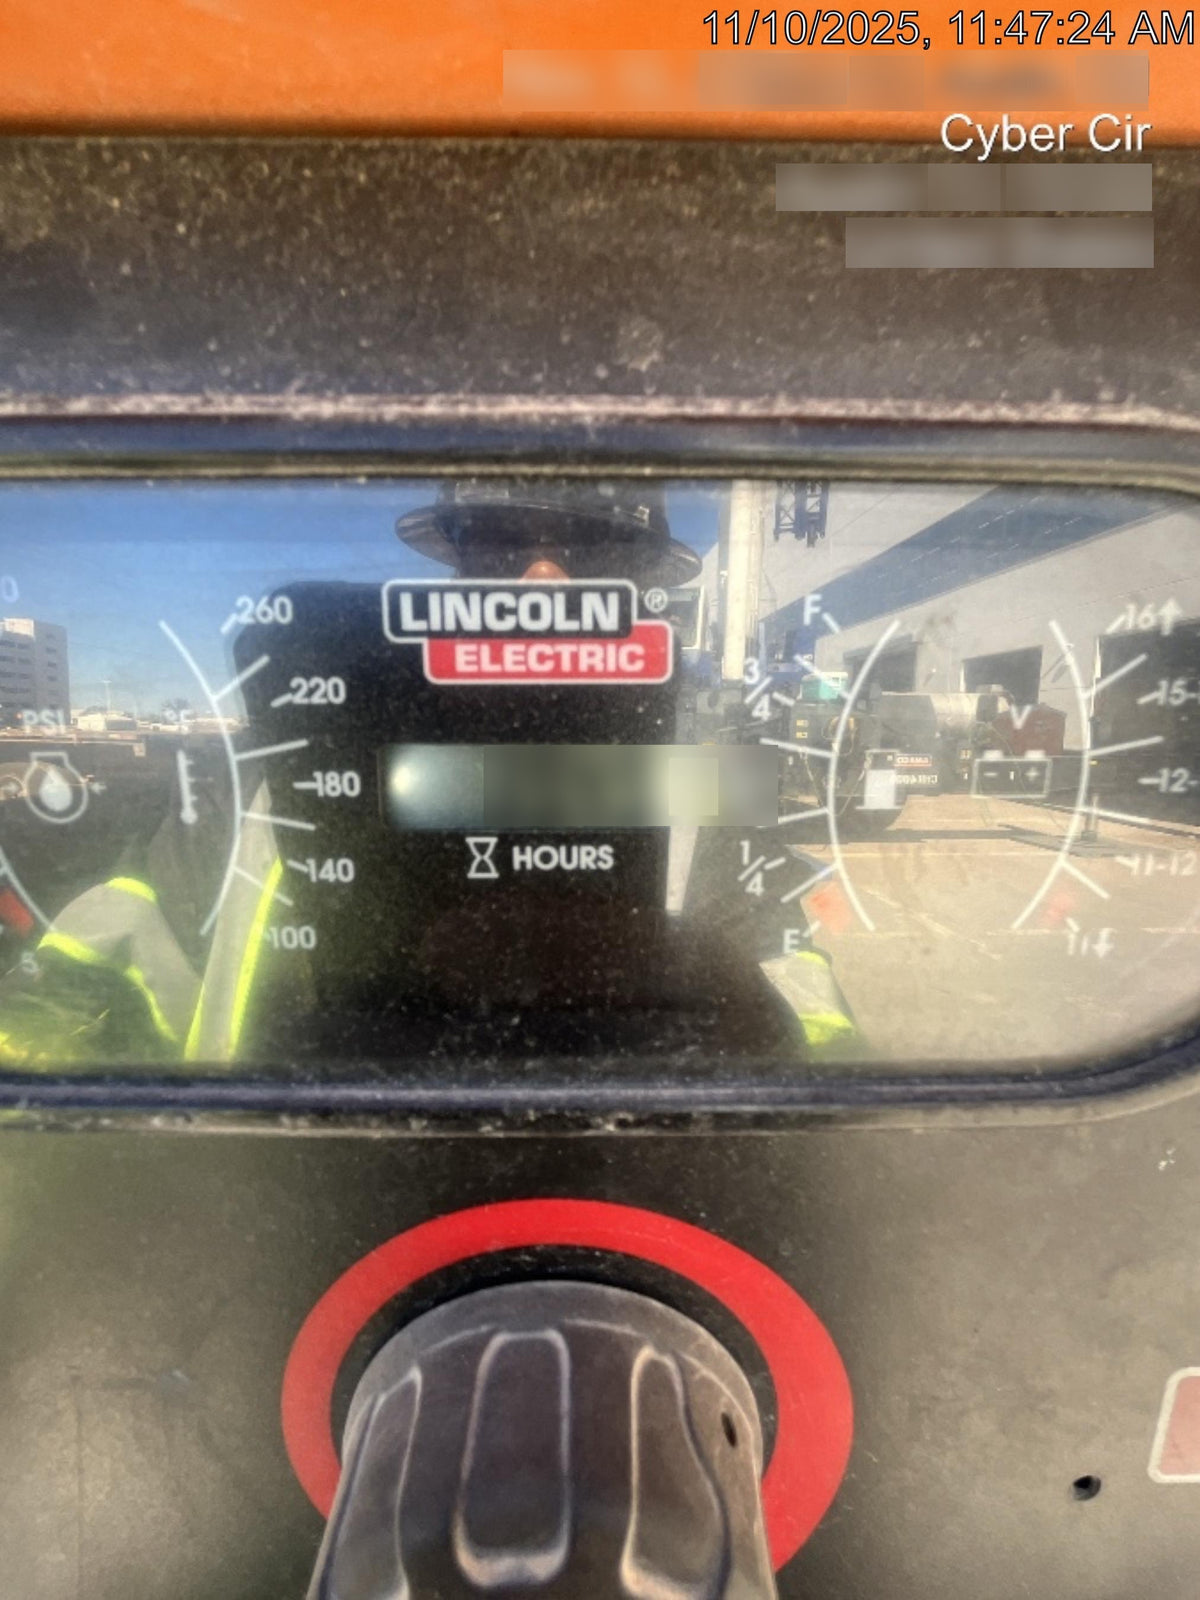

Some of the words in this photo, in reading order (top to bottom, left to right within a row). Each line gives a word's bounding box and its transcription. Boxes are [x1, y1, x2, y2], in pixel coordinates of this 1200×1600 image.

[236, 596, 293, 624] 260
[400, 592, 619, 632] LINCOLN
[803, 594, 822, 627] F
[455, 643, 646, 673] ELECTRIC
[290, 676, 346, 704] 220
[22, 709, 67, 733] PSI
[1010, 703, 1032, 729] V
[313, 771, 361, 797] 180
[306, 858, 355, 883] 140
[512, 845, 614, 871] HOURS
[268, 926, 316, 950] 100
[783, 929, 801, 955] E
